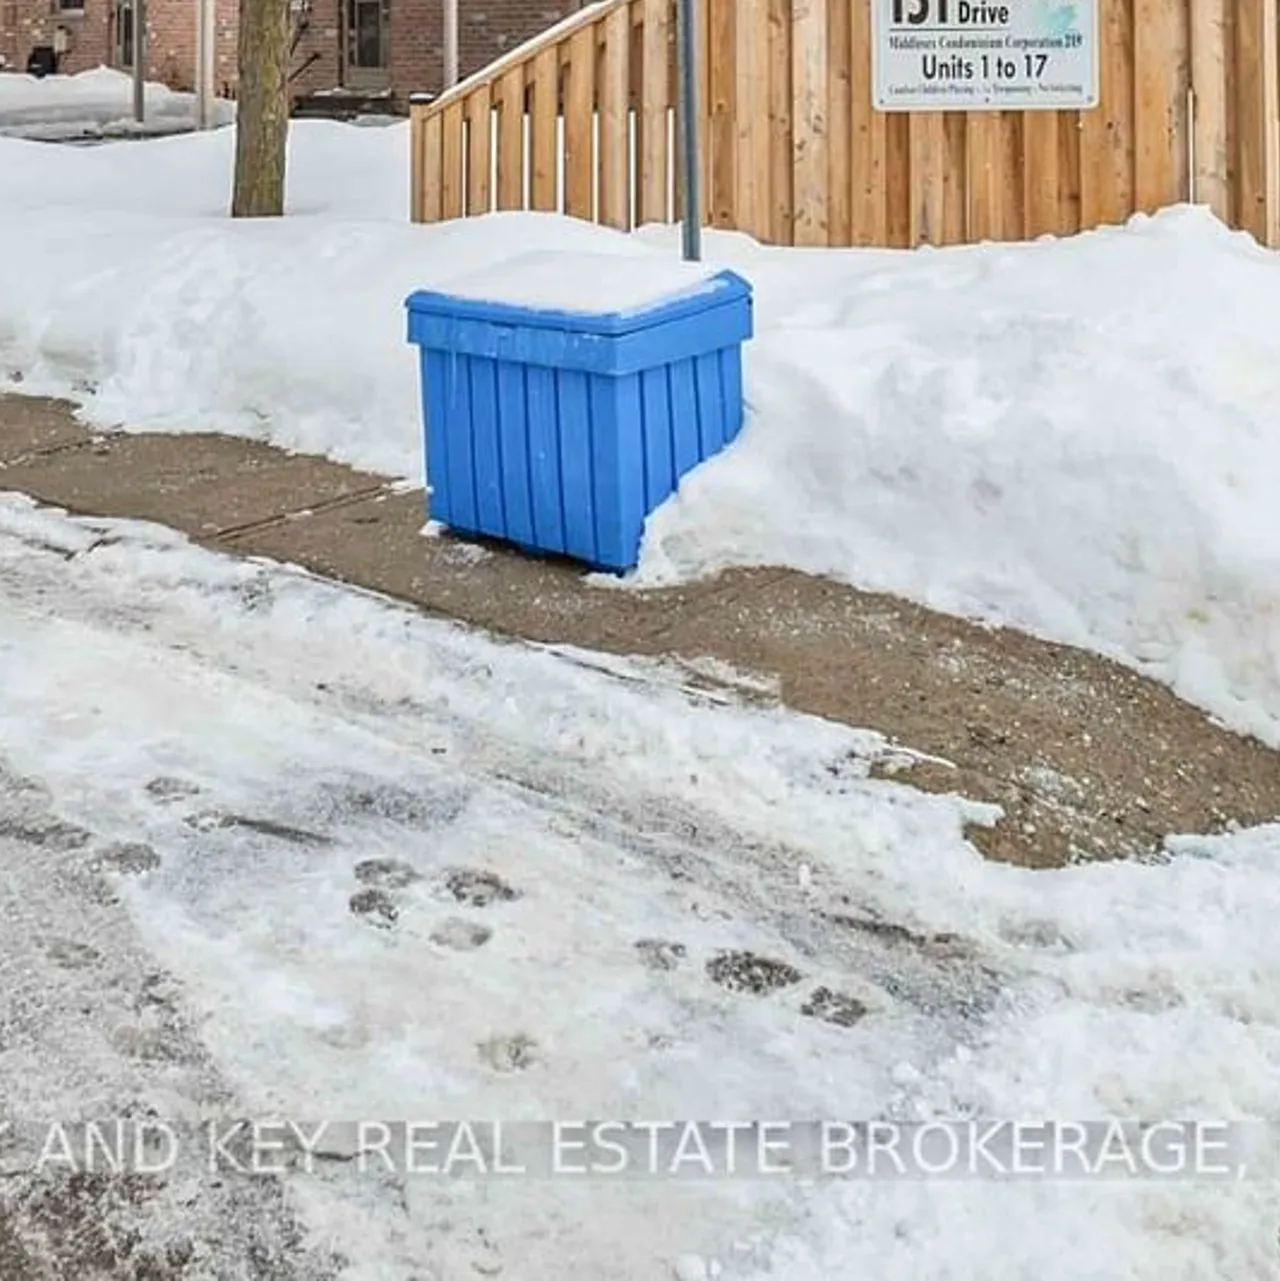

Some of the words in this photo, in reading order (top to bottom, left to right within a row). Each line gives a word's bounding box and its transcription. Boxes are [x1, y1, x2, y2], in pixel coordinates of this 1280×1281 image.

[958, 0, 1010, 25] Drive
[922, 55, 974, 80] Units
[981, 55, 990, 79] 1
[996, 56, 1017, 80] to
[1024, 54, 1048, 78] 17
